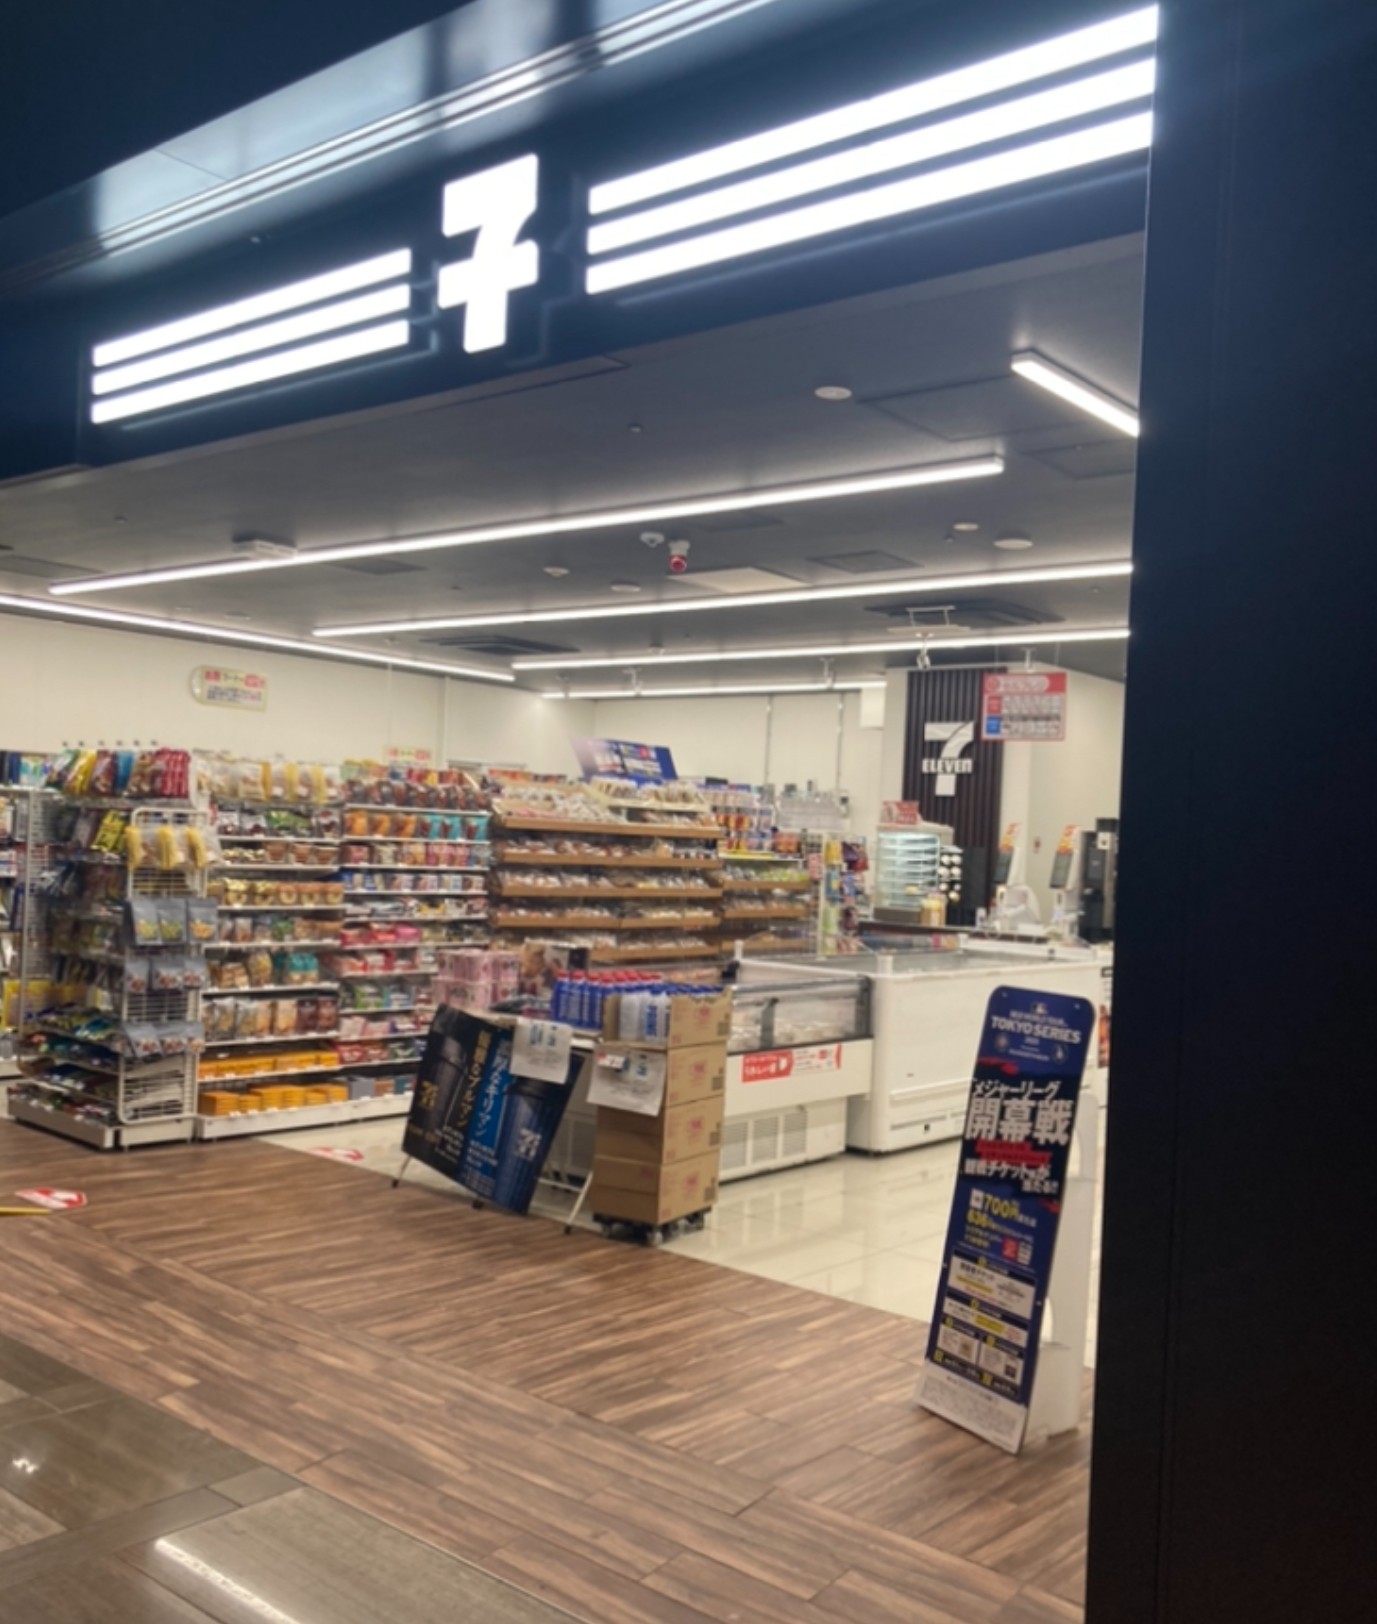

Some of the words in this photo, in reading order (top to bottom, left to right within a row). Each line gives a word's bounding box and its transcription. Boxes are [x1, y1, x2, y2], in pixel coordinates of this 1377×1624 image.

[437, 153, 539, 354] 7
[924, 721, 974, 796] 7
[991, 1014, 1033, 1036] TOKYO
[1033, 1022, 1082, 1045] SERIES
[972, 1079, 1062, 1100] メジャーリーグ
[965, 1097, 1074, 1145] 開幕戦
